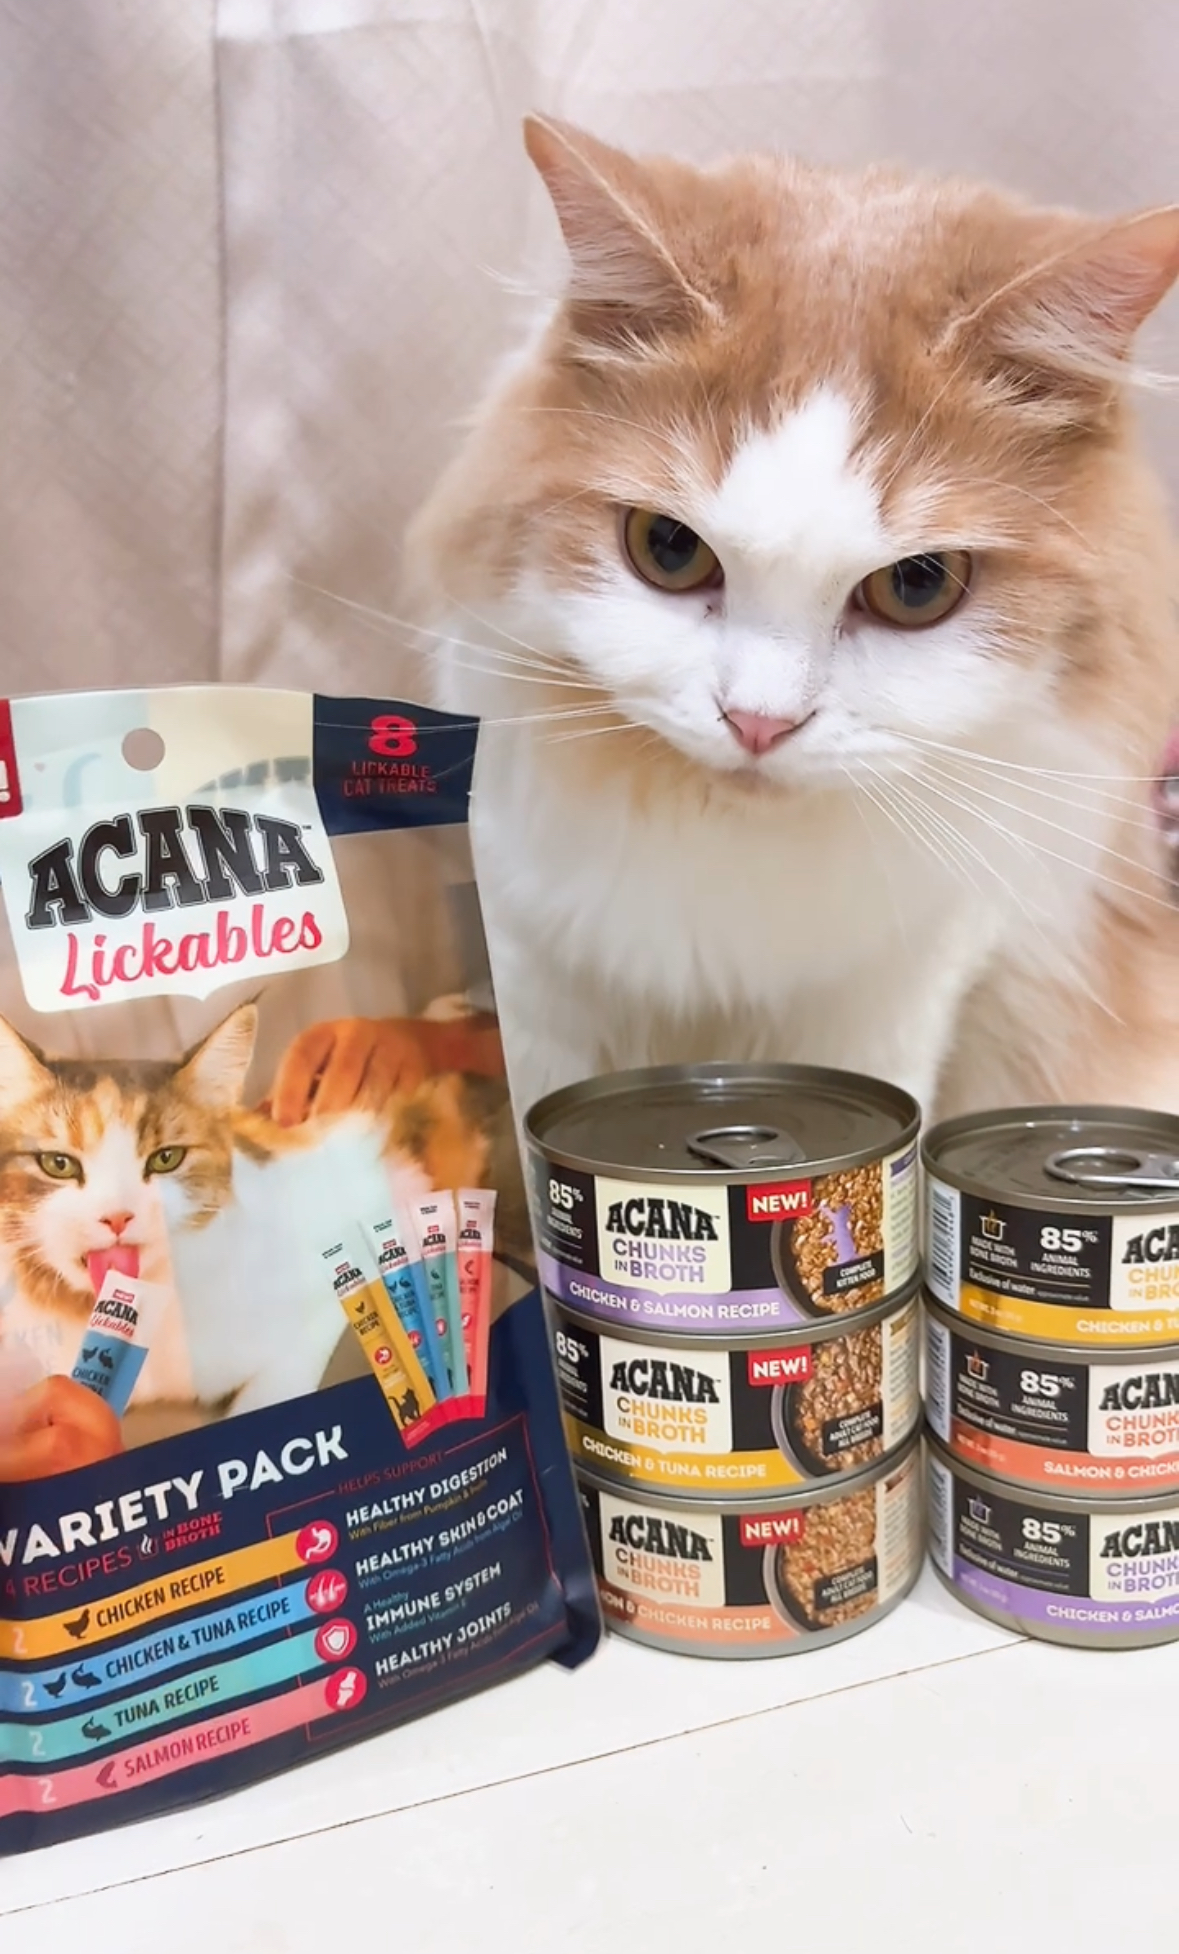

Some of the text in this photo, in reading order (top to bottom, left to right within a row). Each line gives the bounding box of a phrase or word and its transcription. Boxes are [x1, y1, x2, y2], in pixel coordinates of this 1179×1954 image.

[368, 714, 417, 757] 8
[352, 760, 431, 779] LICKABLE
[343, 777, 437, 798] CAT TREATS
[25, 804, 325, 929] ACANA
[60, 904, 322, 1000] Lickables
[549, 1179, 584, 1209] 85%
[752, 1191, 808, 1214] NEW!
[605, 1197, 719, 1241] ACANA
[612, 1238, 707, 1264] CHUNKS
[1040, 1226, 1099, 1253] 85%
[615, 1259, 705, 1283] IN BROTH
[1030, 1261, 1092, 1278] INGREDIENTS
[1041, 1253, 1079, 1266] ANIMAL
[569, 1281, 780, 1319] CHICKEN & SALMON RECIPE
[1129, 1288, 1143, 1298] IN
[95, 1299, 139, 1325] ACANA
[1076, 1319, 1163, 1334] CHICKEN &
[556, 1331, 589, 1363] 85%
[610, 1358, 720, 1404] ACANA
[753, 1356, 808, 1379] NEW!
[1020, 1370, 1076, 1397] 85%
[616, 1396, 708, 1425] CHUNKS
[1011, 1403, 1069, 1422] INGREDIENTS
[618, 1416, 706, 1444] IN BROTH
[1106, 1427, 1179, 1447] IN BROT
[582, 1435, 767, 1479] CHICKEN & TUNA RECIPE
[1044, 1460, 1125, 1479] SALMON &
[339, 1452, 442, 1493] HELPS SUPPORT
[0, 1425, 348, 1566] VARIETY PACK
[346, 1487, 426, 1528] HEALTHY
[430, 1447, 508, 1499] DIGESTION
[162, 1511, 223, 1540] IN BONE
[164, 1525, 222, 1552] BROTH
[348, 1527, 373, 1541] With
[373, 1516, 398, 1532] Fiber
[355, 1535, 434, 1577] HEALTHY
[438, 1517, 477, 1547] SKIN
[487, 1488, 524, 1520] COAT
[608, 1515, 713, 1562] ACANA
[745, 1518, 799, 1540] NEW!
[1022, 1517, 1077, 1544] 85%
[23, 1546, 133, 1597] RECIPES
[615, 1547, 701, 1580] CHUNKS
[1013, 1547, 1070, 1568] INGREDIENTS
[617, 1565, 700, 1598] IN BROTH
[1108, 1571, 1179, 1593] IN BROT
[12, 1566, 226, 1655] 2 CHICKEN RECIPE
[366, 1562, 502, 1632] IMMUNE SYSTEM
[372, 1591, 410, 1610] Healthy
[637, 1605, 709, 1629] CHICKEN
[712, 1617, 772, 1631] RECIPE
[1046, 1604, 1119, 1622] CHICKEN
[1121, 1610, 1132, 1623] &
[21, 1597, 291, 1708] 2 CHICKEN & TUNA RECIPE
[375, 1602, 512, 1677] HEALTHY JOINTS
[29, 1675, 220, 1757] 2 TUNA RECIPE
[38, 1717, 252, 1804] 2 SALMON RECIPE
